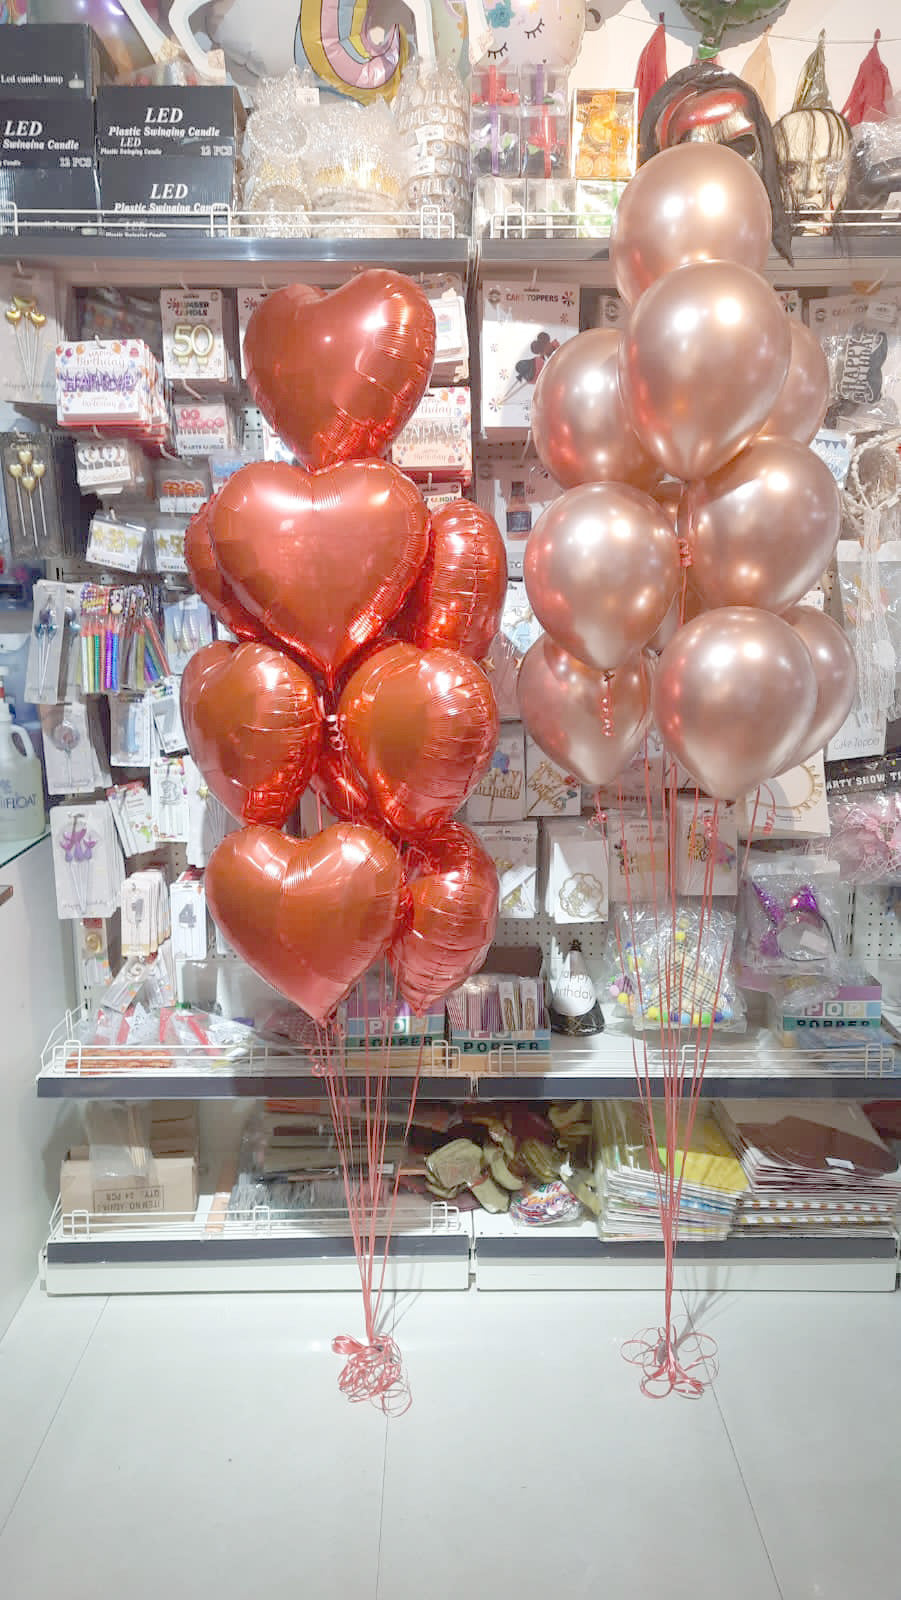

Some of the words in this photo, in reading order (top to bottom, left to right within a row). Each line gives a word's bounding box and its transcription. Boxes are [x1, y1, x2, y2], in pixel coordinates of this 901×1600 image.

[144, 107, 183, 123] LED
[4, 120, 43, 136] LED
[108, 126, 141, 137] Plastic
[143, 126, 186, 138] Swinging
[188, 126, 220, 137] Candle
[3, 139, 45, 150] Swinging
[47, 139, 79, 150] Candle
[120, 137, 142, 148] LED
[213, 146, 233, 156] PCS
[150, 183, 188, 199] LED
[114, 202, 147, 212] Plastic
[173, 325, 213, 356] 50
[826, 779, 852, 789] ARTY
[855, 774, 885, 786] SHOW
[562, 970, 592, 984] appy
